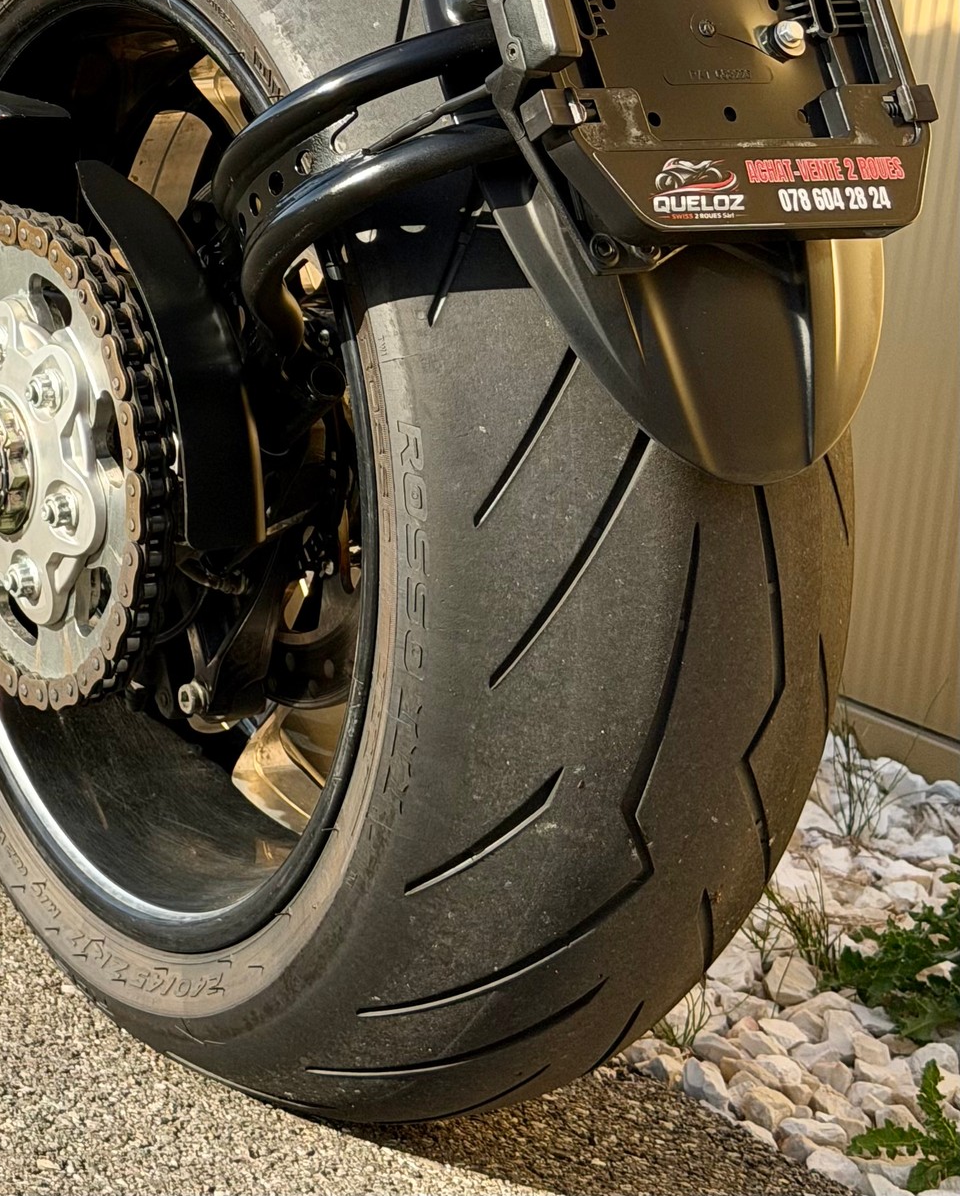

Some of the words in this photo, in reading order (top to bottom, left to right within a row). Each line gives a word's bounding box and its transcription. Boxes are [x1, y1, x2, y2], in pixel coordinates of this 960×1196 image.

[745, 157, 842, 183] ACHAT-VENTE
[843, 159, 857, 182] 2
[857, 156, 906, 181] ROUES
[653, 194, 745, 213] QUELOZ
[778, 186, 811, 212] 078
[813, 186, 843, 211] 604
[845, 185, 869, 210] 28
[869, 183, 892, 210] 24
[396, 420, 430, 681] ROSSO
